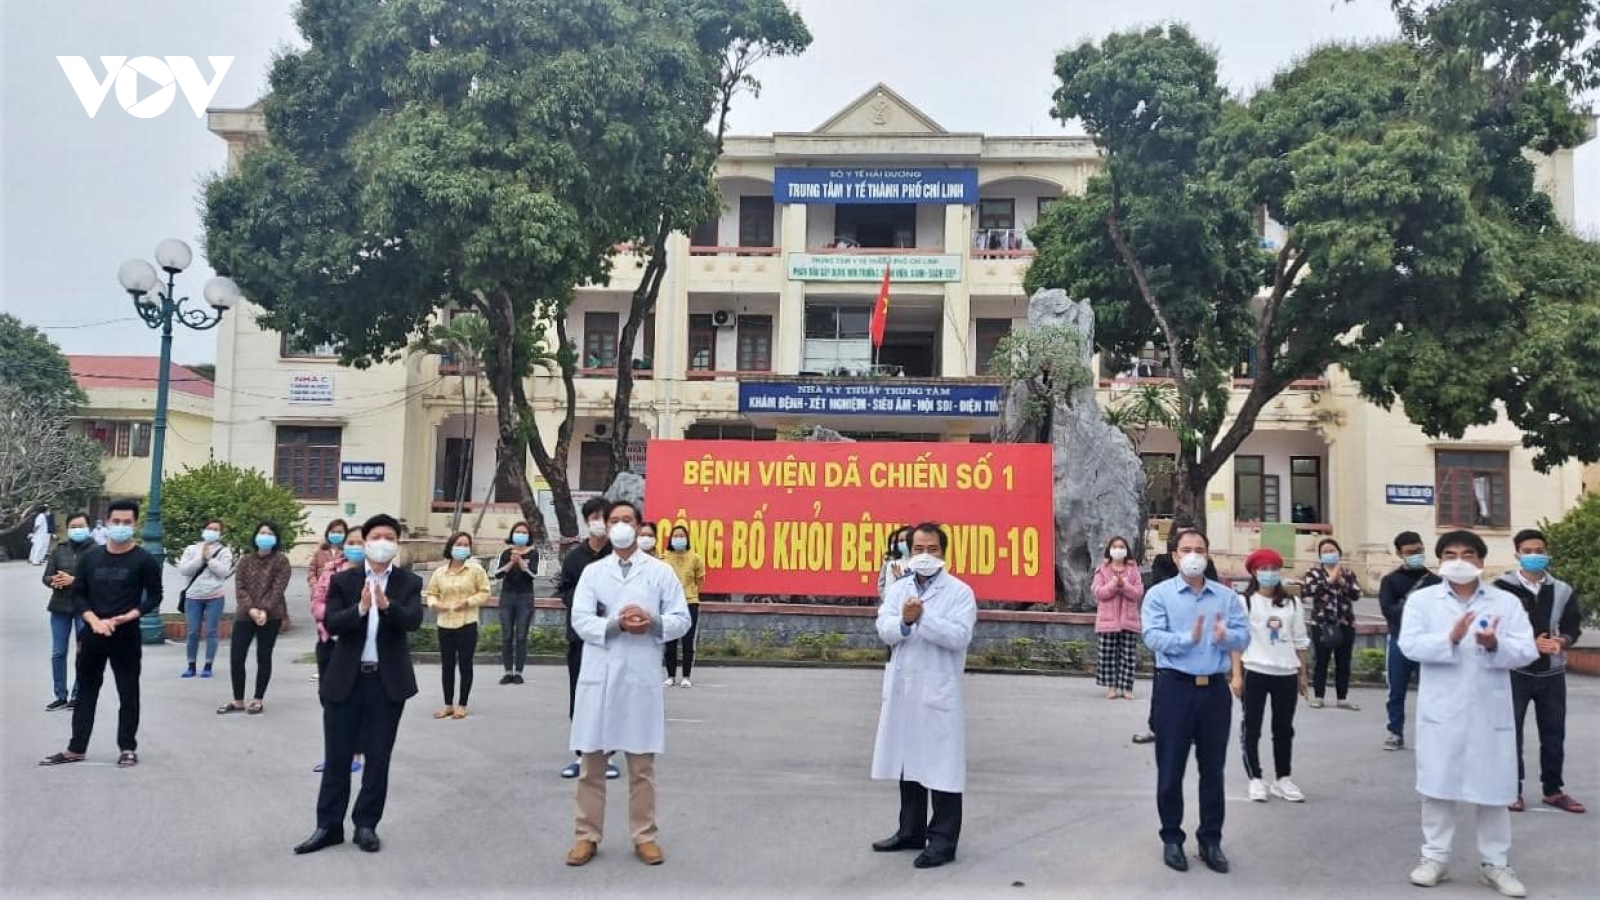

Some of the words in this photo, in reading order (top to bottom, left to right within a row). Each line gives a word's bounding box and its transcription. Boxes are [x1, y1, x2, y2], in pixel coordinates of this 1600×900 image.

[788, 182, 821, 198] TRUNG
[823, 180, 843, 198] TÂM
[846, 183, 852, 198] Y
[855, 180, 867, 198] TẾ
[868, 181, 900, 198] THÀNH
[902, 179, 922, 198] PHỐ
[924, 180, 941, 198] CHÍ
[942, 183, 964, 198] LINH
[885, 387, 923, 395] TRUNG
[925, 386, 950, 395] TÂM
[749, 396, 776, 409] KHÁM
[778, 396, 804, 411] BỆNH
[809, 395, 826, 410] XÉT
[829, 398, 866, 411] NGHIỆM
[872, 396, 894, 411] SIÊU
[935, 399, 953, 412] SOI
[683, 453, 750, 493] BỆNH
[758, 454, 816, 494] VIỆN
[824, 456, 861, 488] DÃ
[869, 451, 948, 489] CHIẾN
[955, 451, 994, 490] SỐ
[1003, 465, 1014, 490] 1
[731, 503, 769, 570] BỐ
[773, 501, 832, 572] KHỎI
[841, 511, 908, 584] BỆN
[938, 524, 1039, 577] OVID-19
